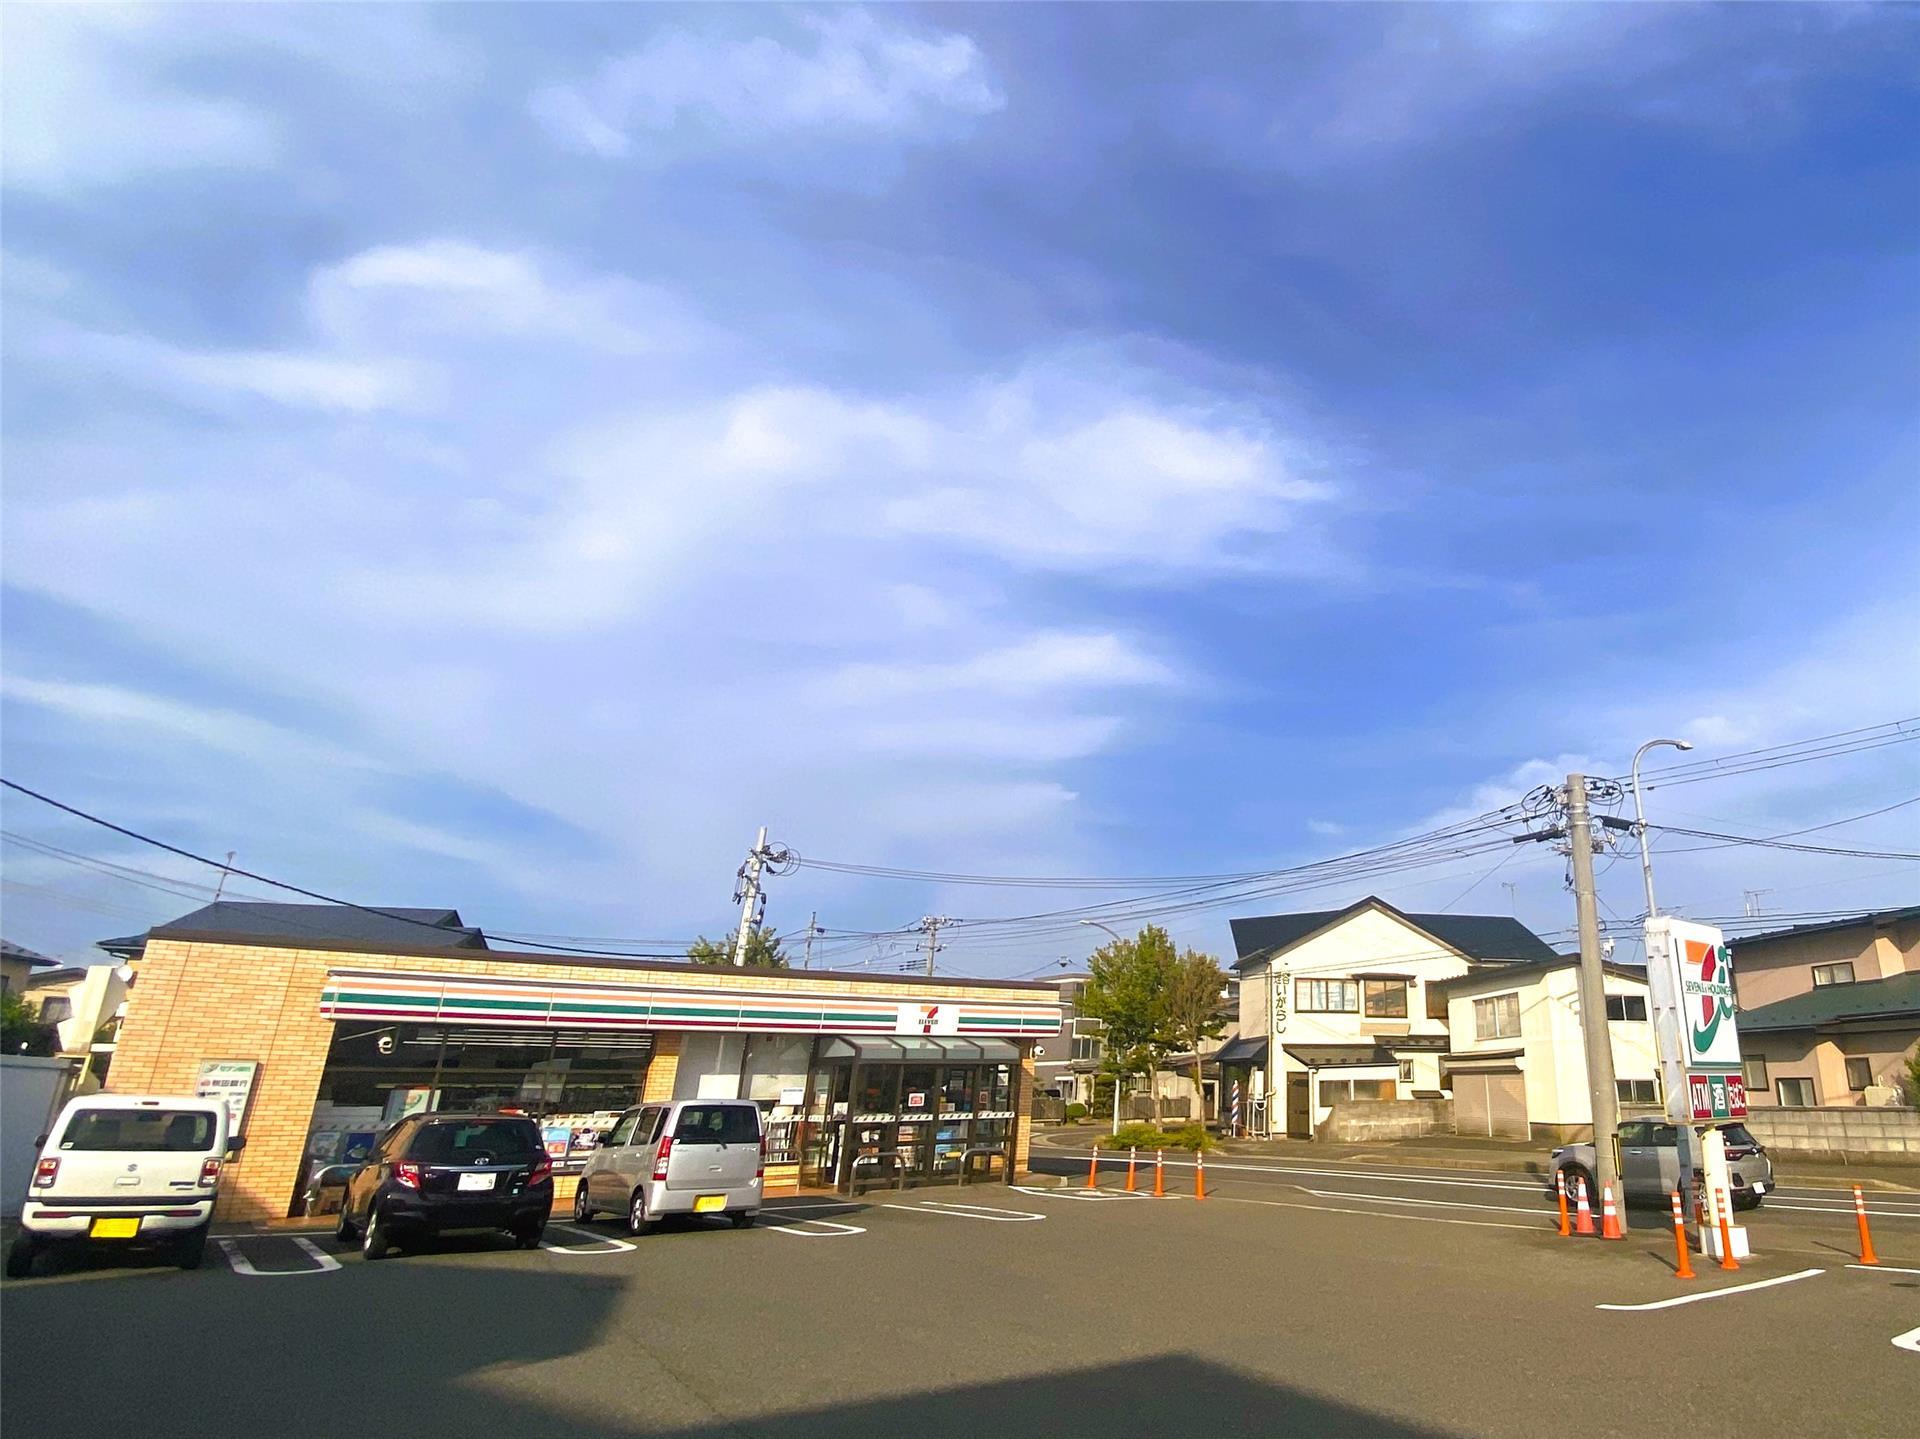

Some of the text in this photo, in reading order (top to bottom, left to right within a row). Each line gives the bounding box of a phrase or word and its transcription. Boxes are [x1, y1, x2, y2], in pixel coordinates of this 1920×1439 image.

[1275, 985, 1287, 1034] いがらし
[1692, 1083, 1711, 1111] ATM
[1711, 1083, 1726, 1110] 酒
[1727, 1082, 1746, 1109] たばこ
